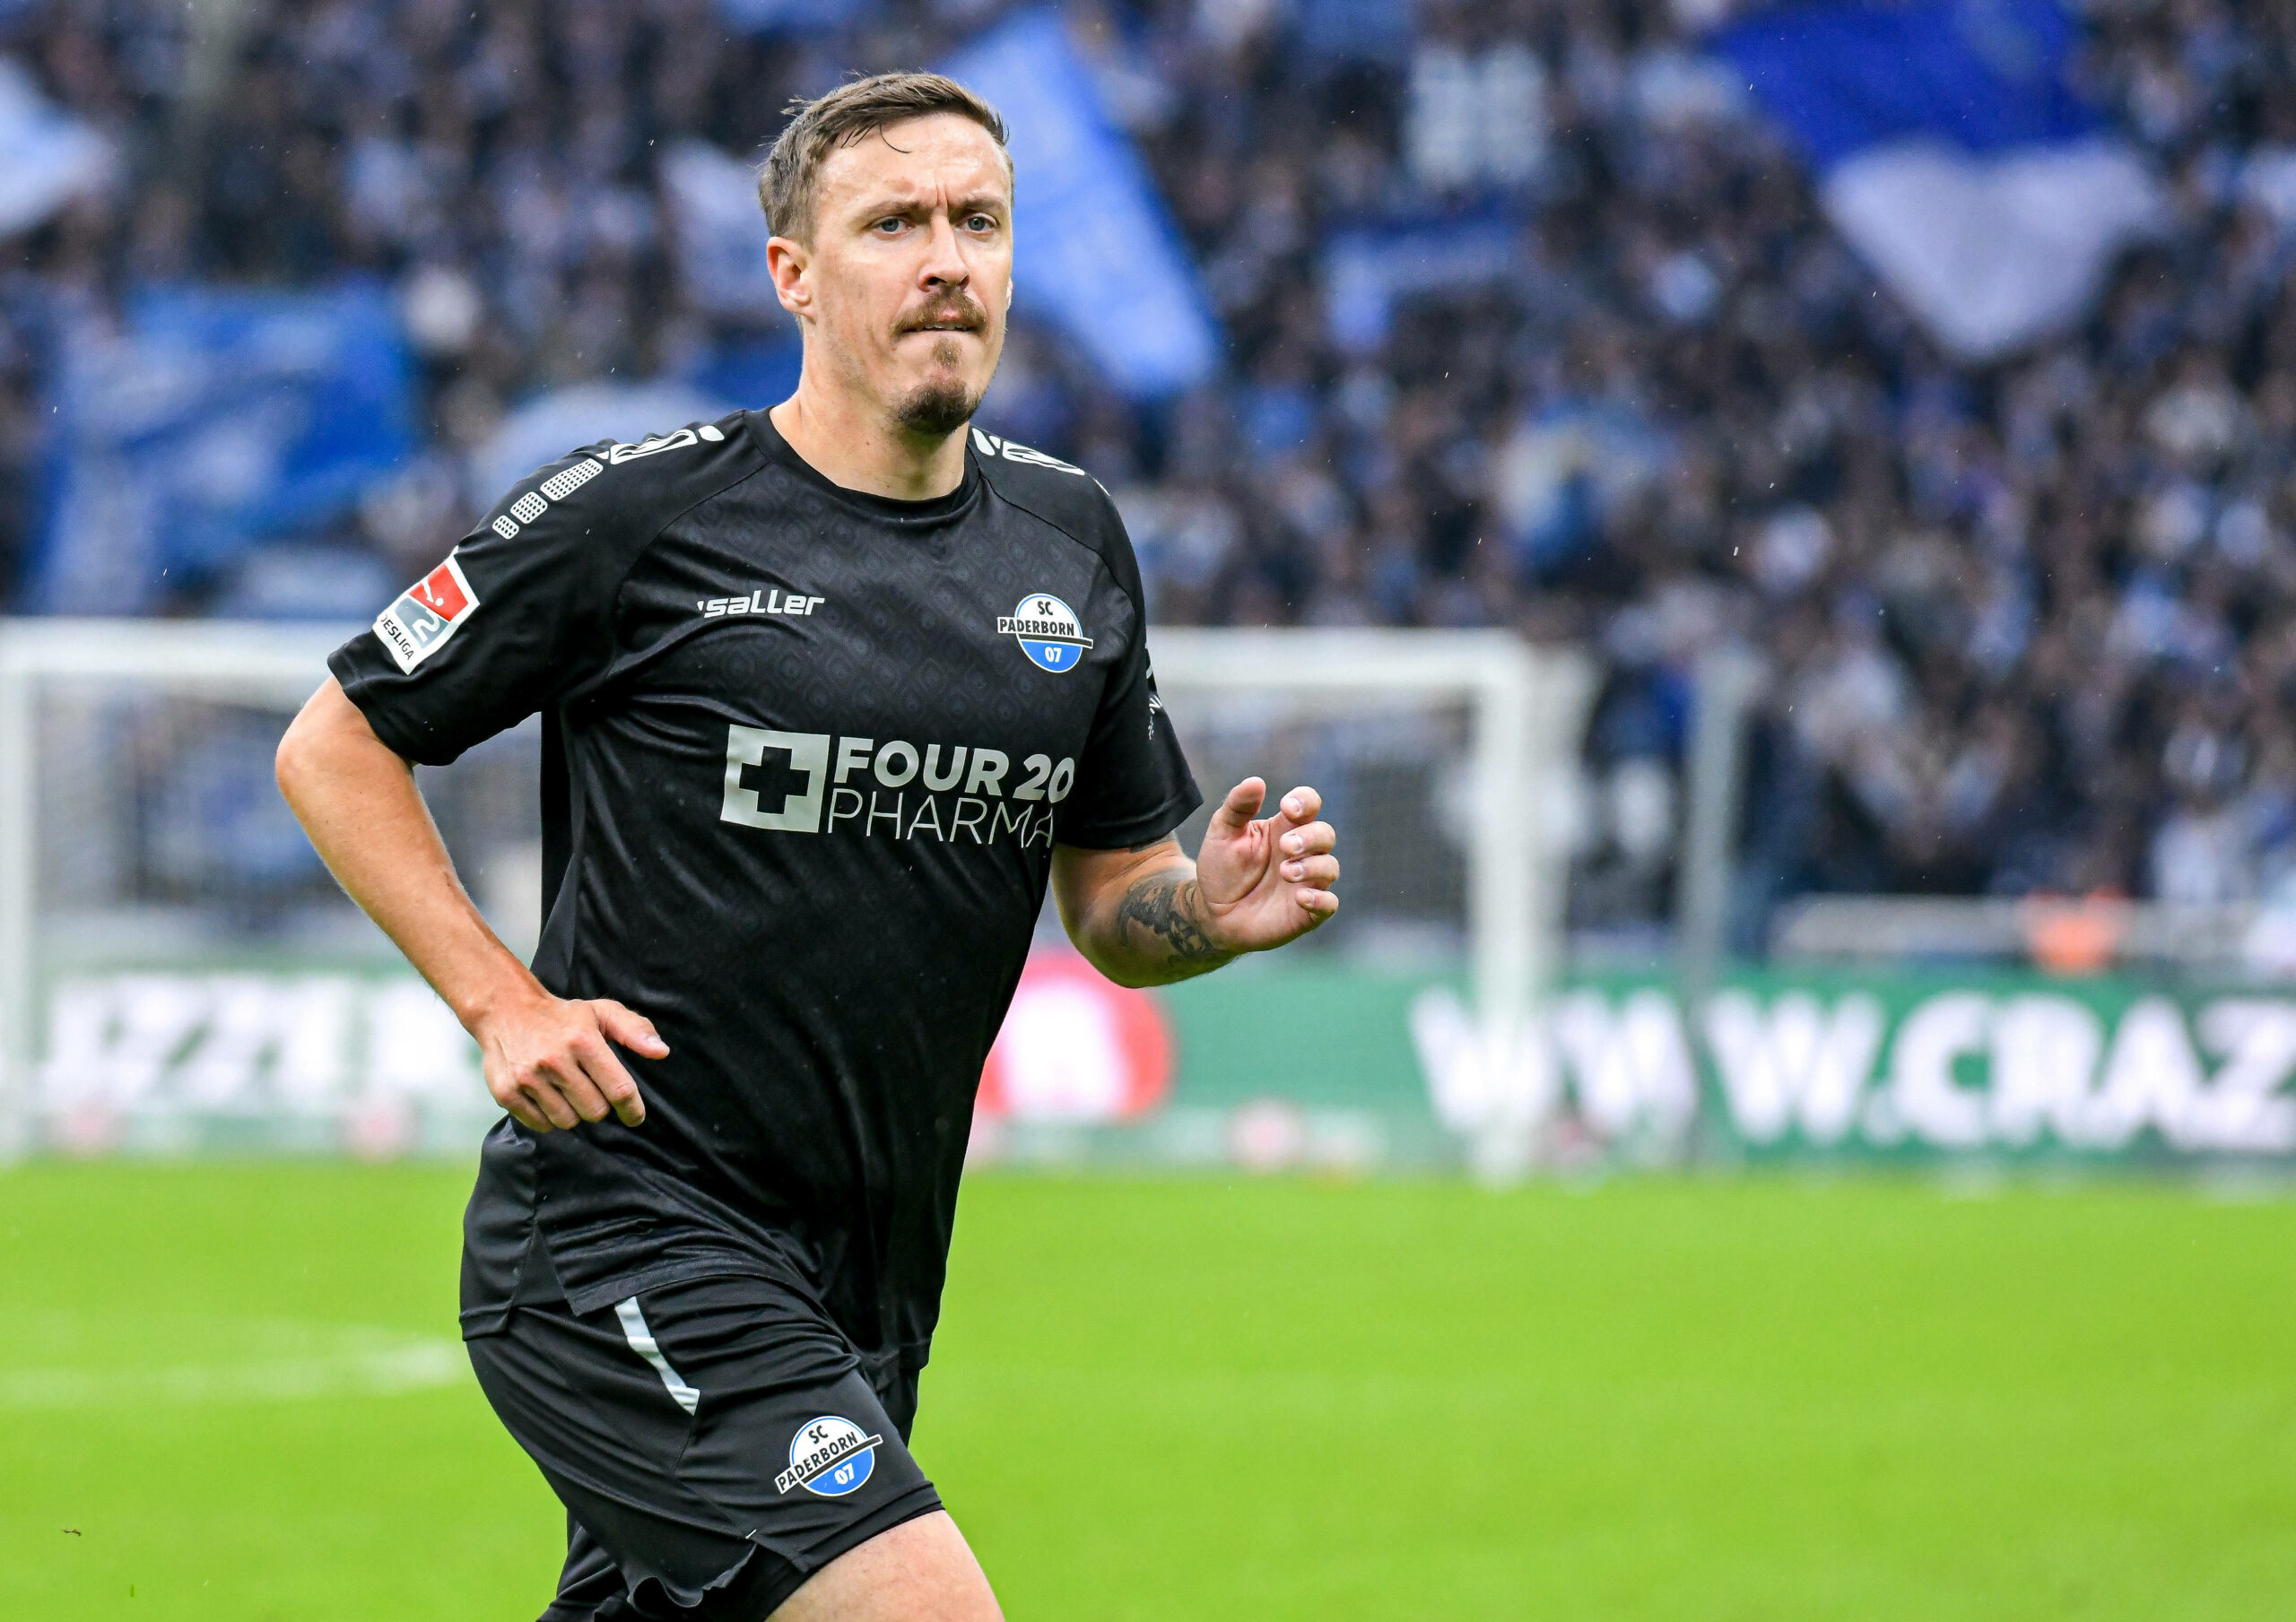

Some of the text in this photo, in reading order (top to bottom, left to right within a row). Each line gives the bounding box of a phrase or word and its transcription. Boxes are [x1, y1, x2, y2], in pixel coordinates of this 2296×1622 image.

[1037, 600, 1054, 616] SC
[379, 613, 415, 661] ESLIGA
[999, 618, 1075, 637] PADERBORN
[1044, 646, 1063, 664] 07
[833, 736, 1075, 804] FOUR 20
[827, 788, 1054, 848] PHARMA
[808, 1424, 829, 1445] SC
[777, 1431, 858, 1492] PADERBORN
[834, 1462, 856, 1486] 07
